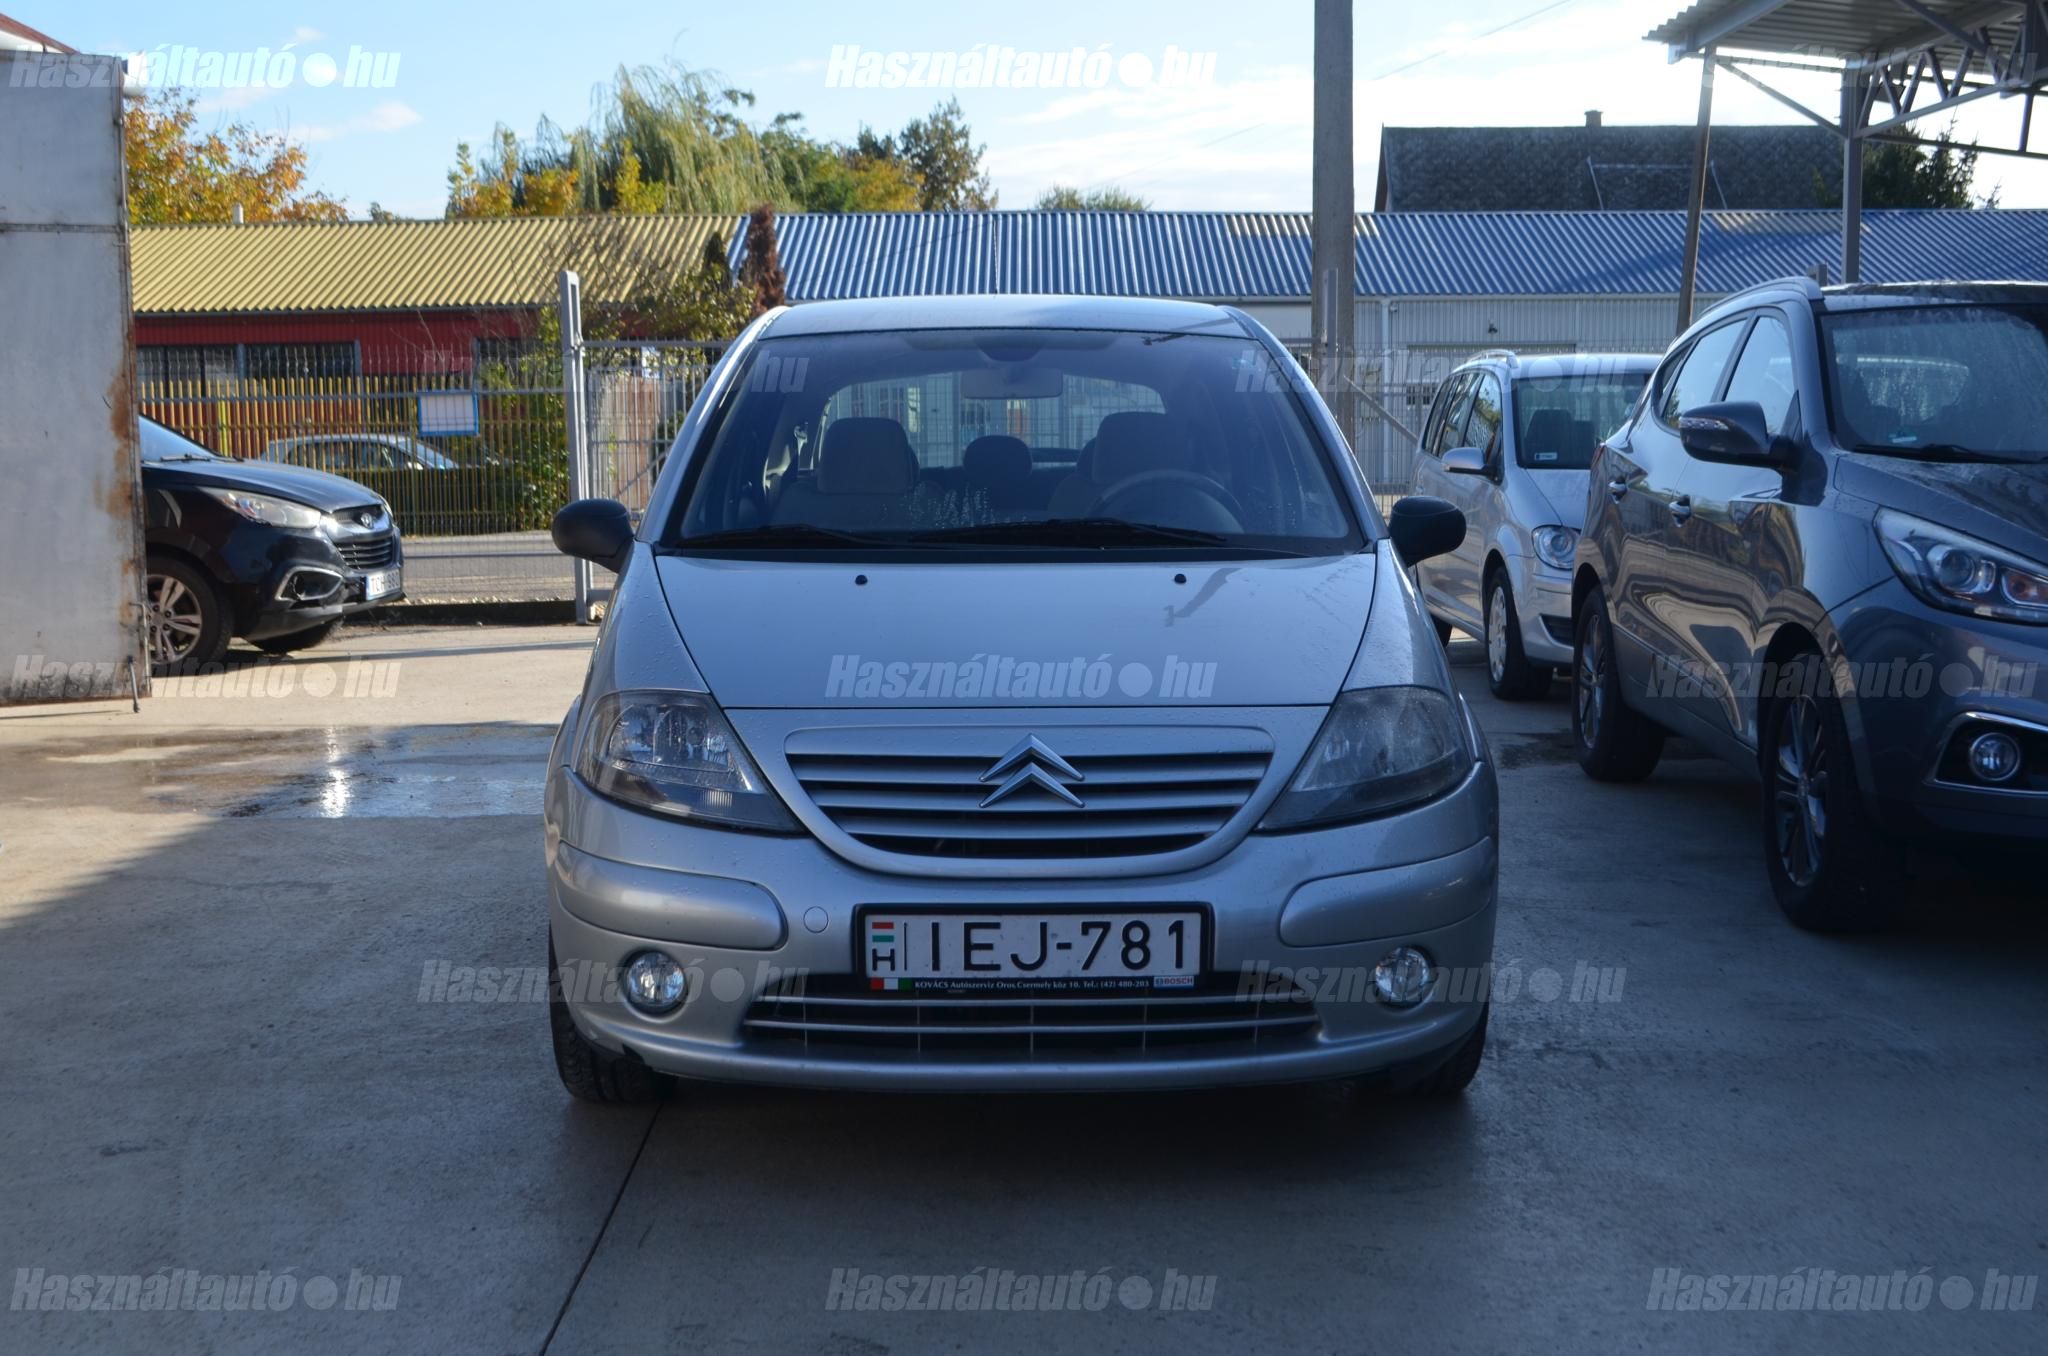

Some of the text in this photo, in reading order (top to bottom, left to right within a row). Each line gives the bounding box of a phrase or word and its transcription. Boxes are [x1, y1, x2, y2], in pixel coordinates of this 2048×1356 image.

[931, 920, 1184, 971] IEJ-781
[914, 980, 949, 989] KOVÁCS
[950, 980, 995, 989] Autószerviz
[1164, 977, 1193, 985] BOSCH
